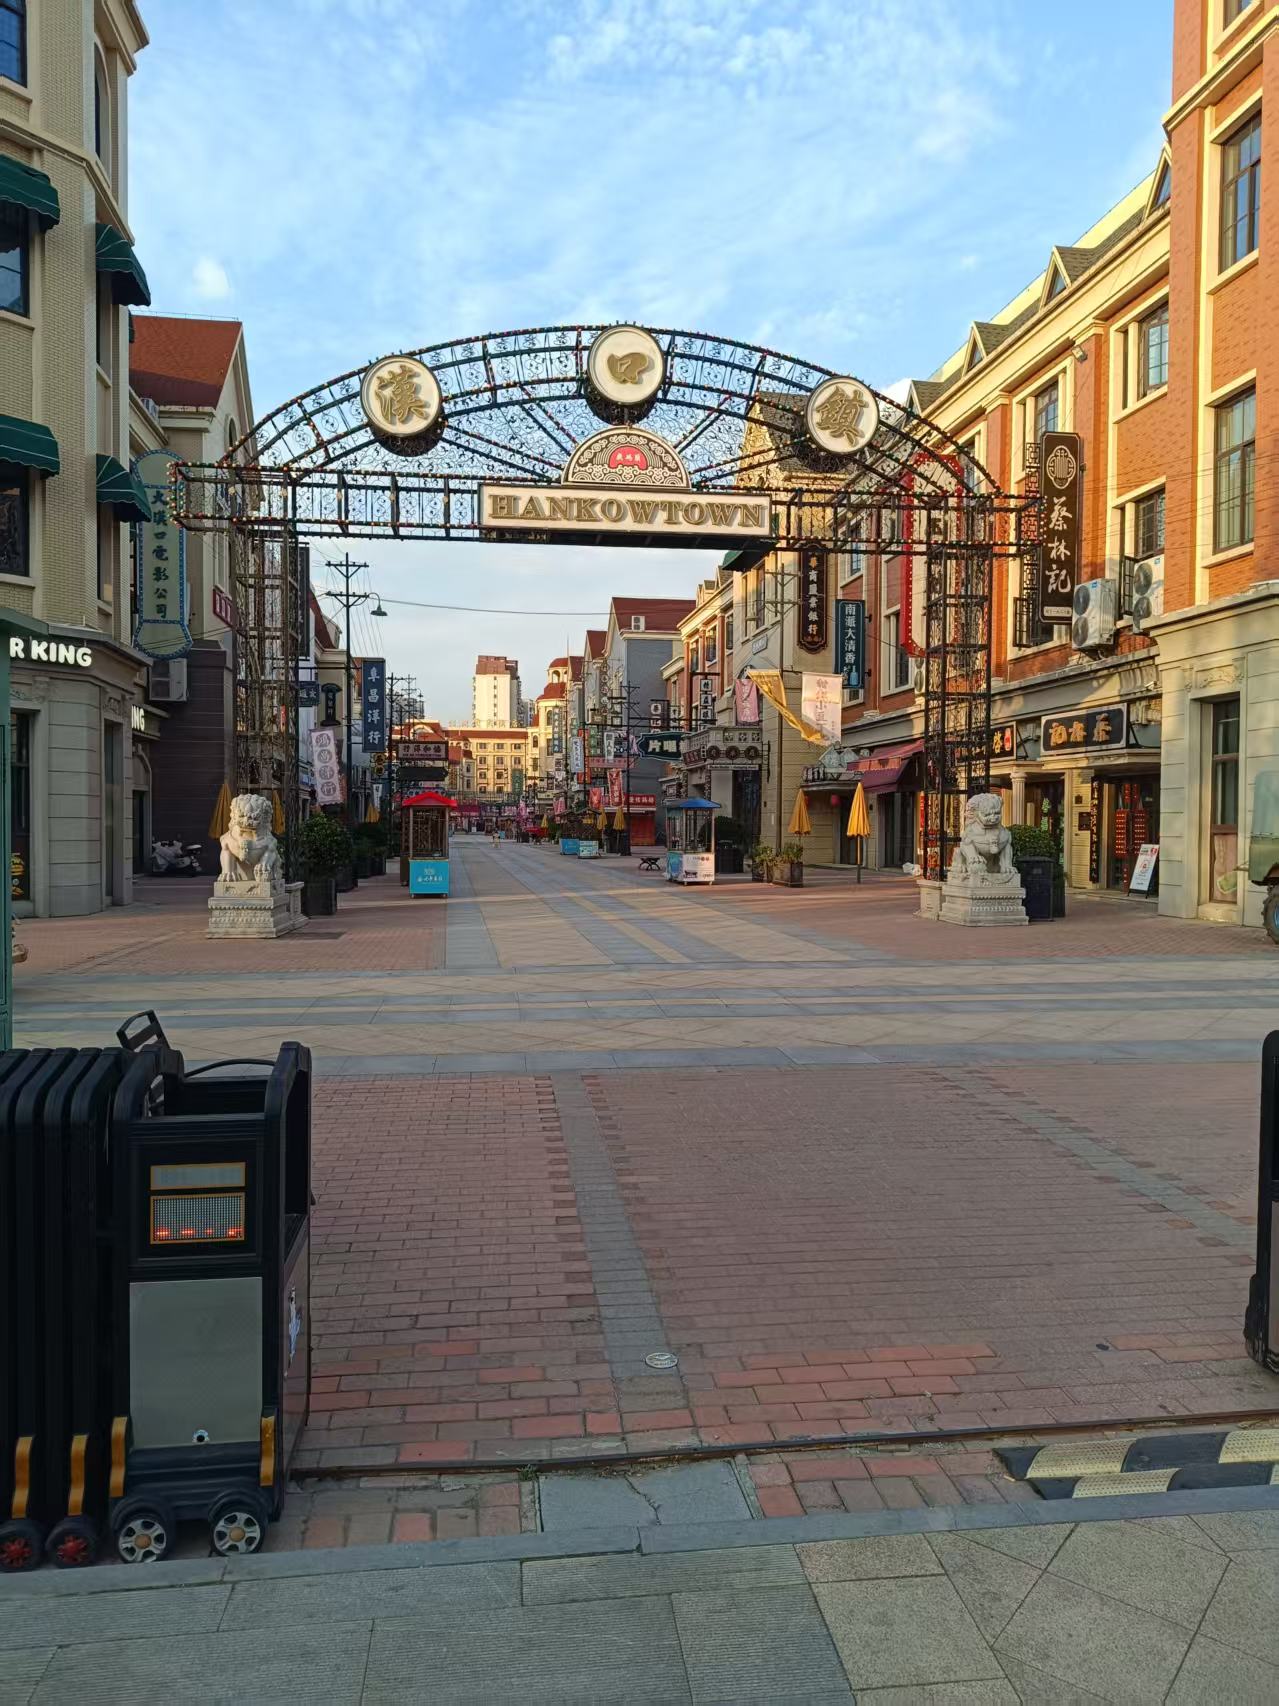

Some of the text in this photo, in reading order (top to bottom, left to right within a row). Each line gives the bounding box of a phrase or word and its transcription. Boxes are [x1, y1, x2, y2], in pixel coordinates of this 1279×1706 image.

[488, 494, 768, 528] HANKOWTOWN
[1045, 496, 1073, 593] 蔡林記
[31, 640, 92, 667] KING
[367, 666, 381, 745] 阜昌洋行
